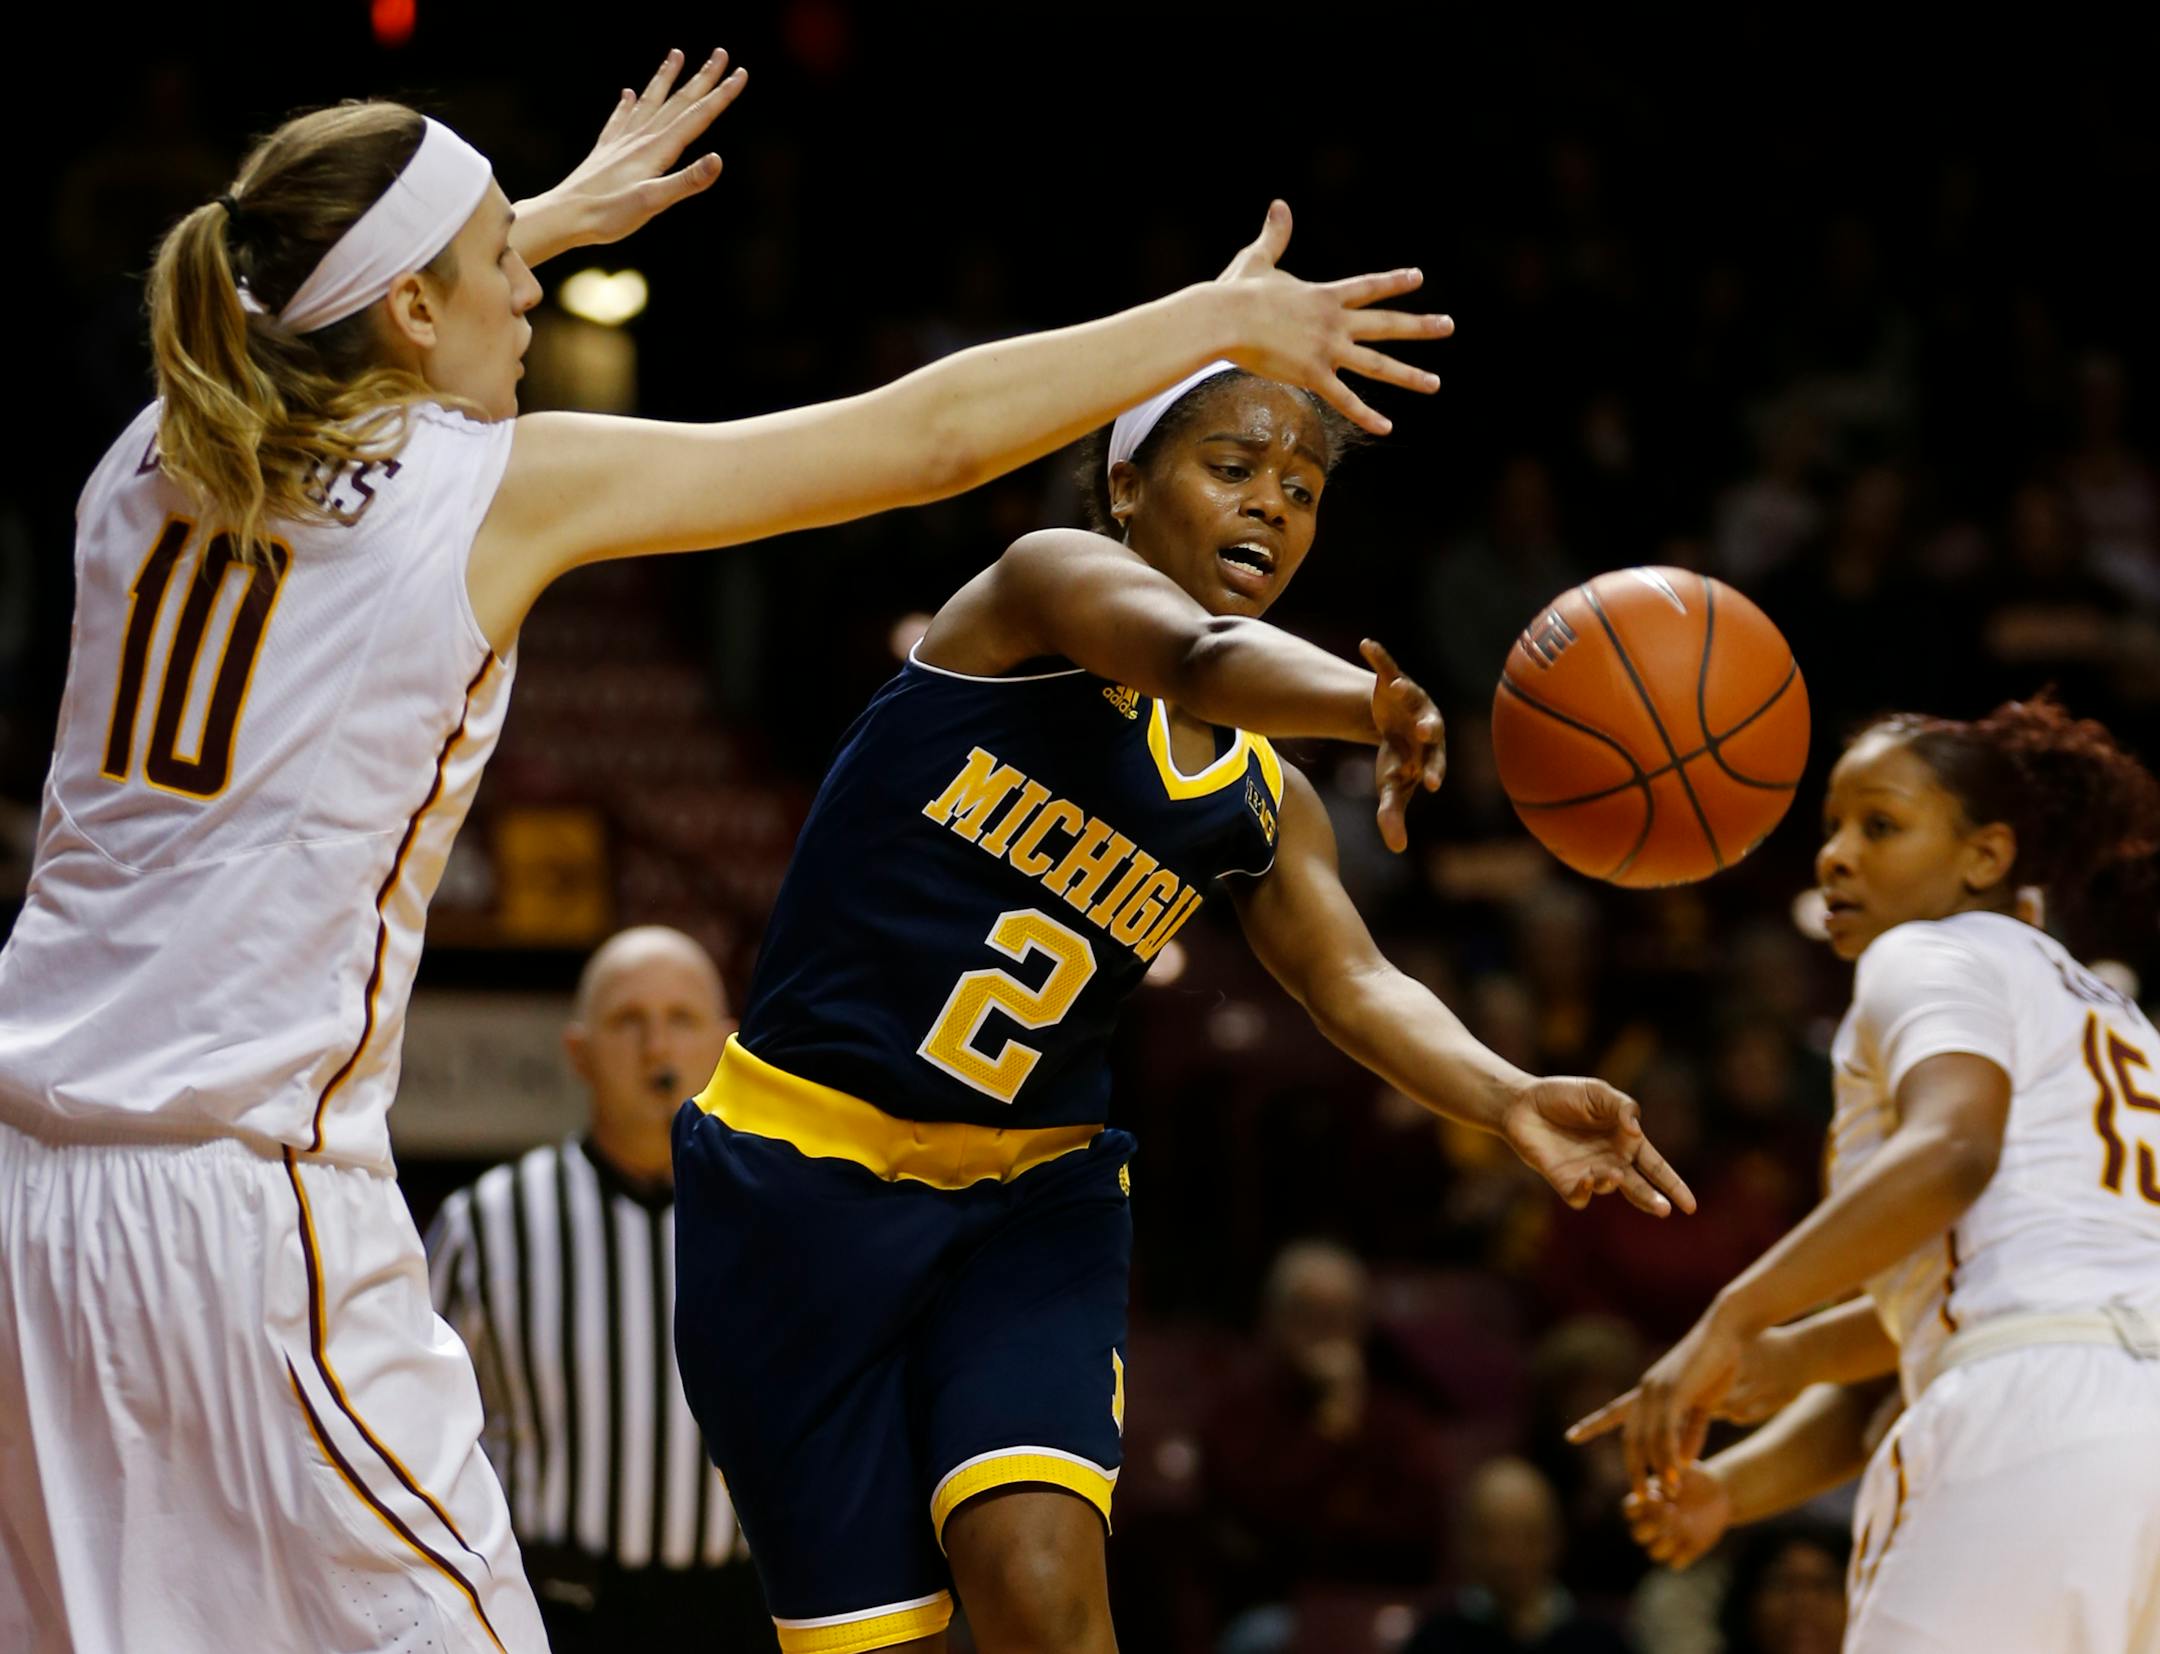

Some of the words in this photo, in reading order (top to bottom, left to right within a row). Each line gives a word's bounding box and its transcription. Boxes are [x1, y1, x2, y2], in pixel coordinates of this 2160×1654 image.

[102, 512, 293, 801] 10
[916, 908, 1098, 1104] 2
[2081, 1007, 2160, 1207] 15
